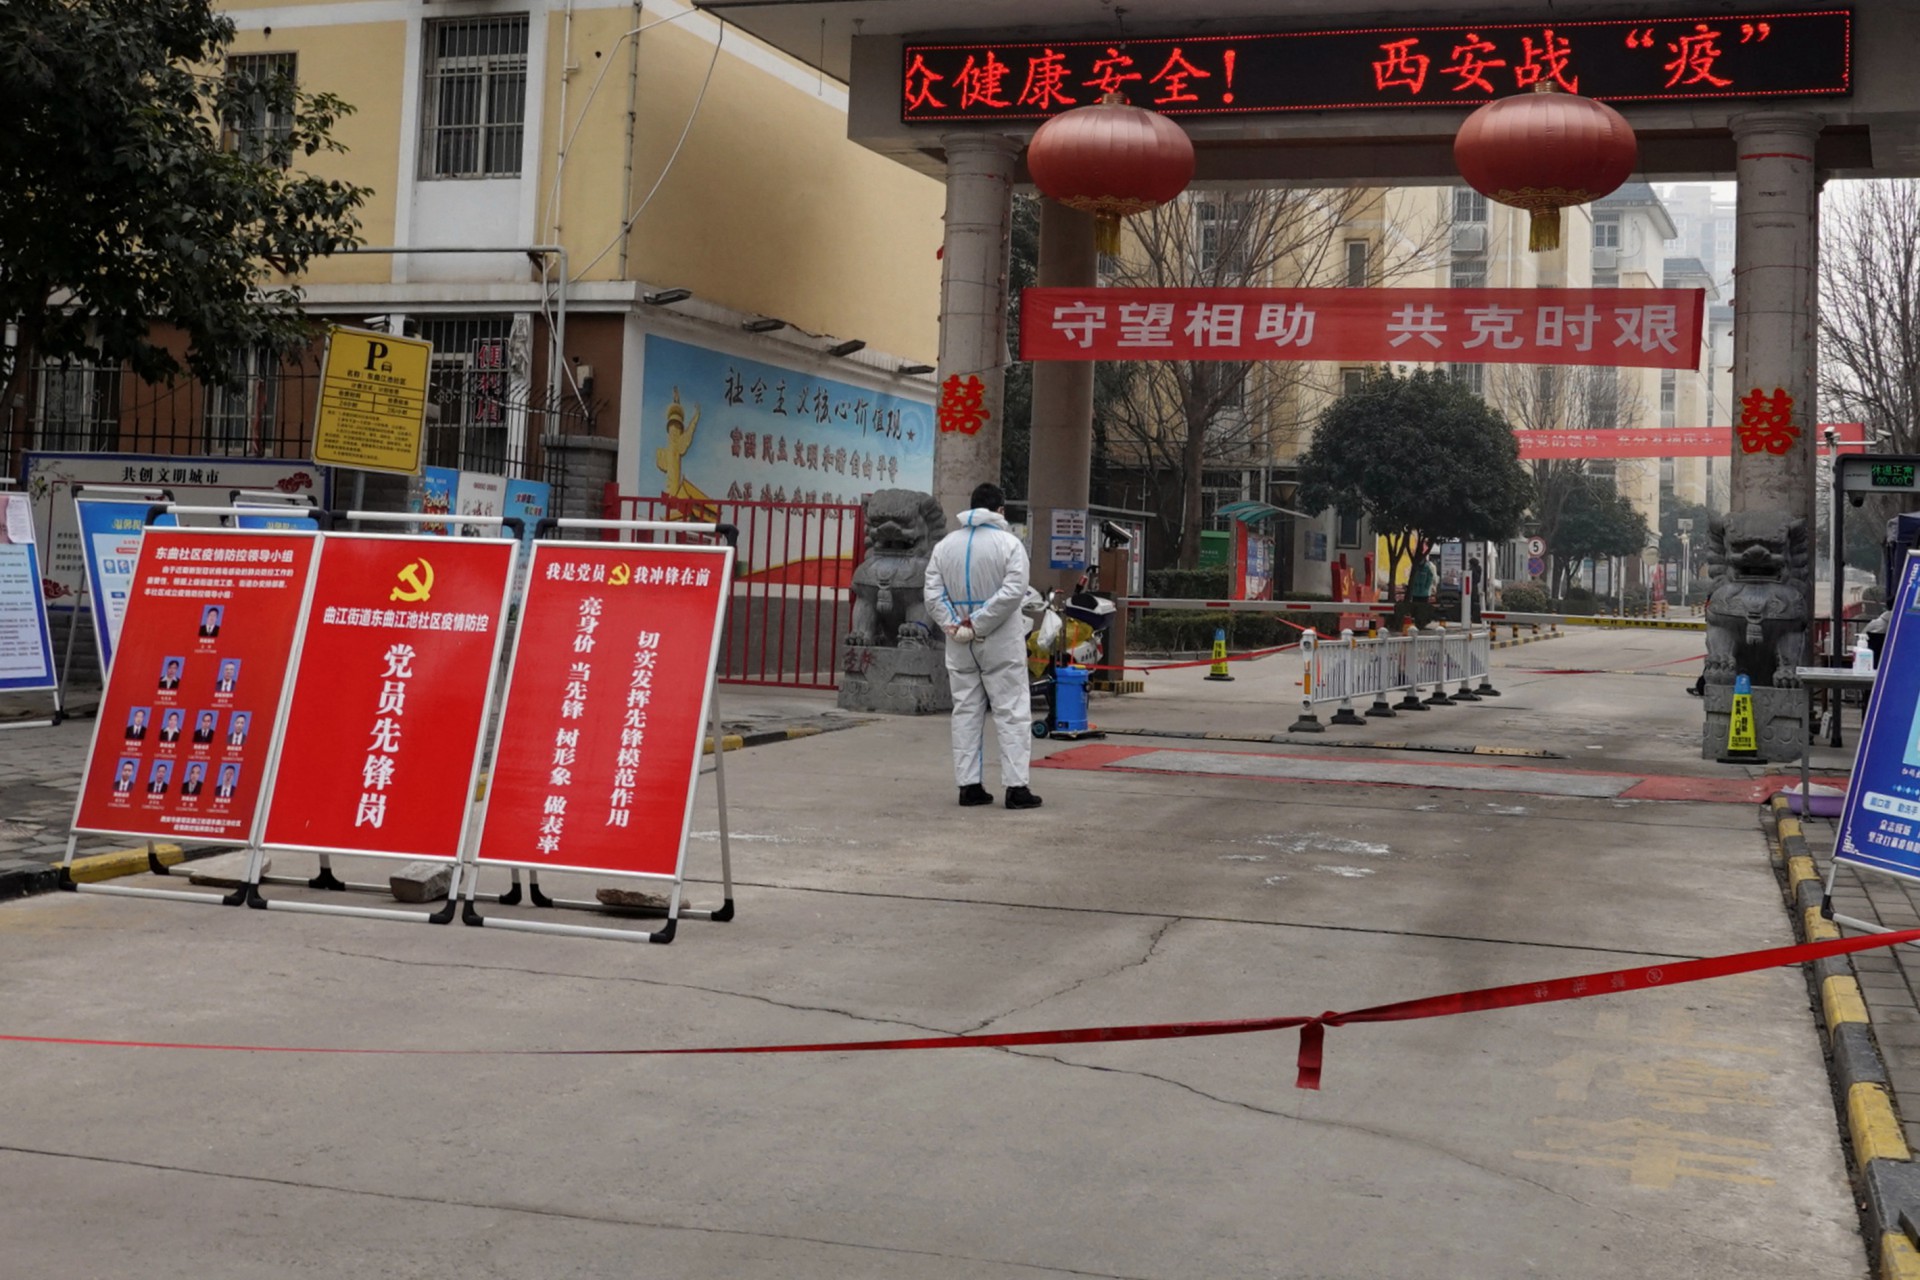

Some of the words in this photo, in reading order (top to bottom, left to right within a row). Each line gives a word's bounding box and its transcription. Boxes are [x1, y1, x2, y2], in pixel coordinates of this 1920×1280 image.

[1052, 300, 1317, 349] 守望相助
[1387, 301, 1680, 354] 共克时艰
[363, 340, 388, 371] P
[724, 367, 902, 441] 社会主义核心价值观
[121, 466, 221, 485] 共创文明城市
[155, 547, 294, 563] 东曲社区疫情防控领导小组
[1532, 541, 1540, 552] 5
[546, 562, 605, 584] 我是党员
[633, 566, 712, 588] 我冲锋在前
[323, 606, 490, 633] 曲江街道东曲江池社区疫情防控
[560, 661, 592, 721] 当先锋
[354, 642, 417, 829] 党员先锋岗
[605, 630, 661, 829] 切实发挥先锋模范作用
[548, 727, 580, 787] 树形象
[535, 794, 568, 855] 做表率
